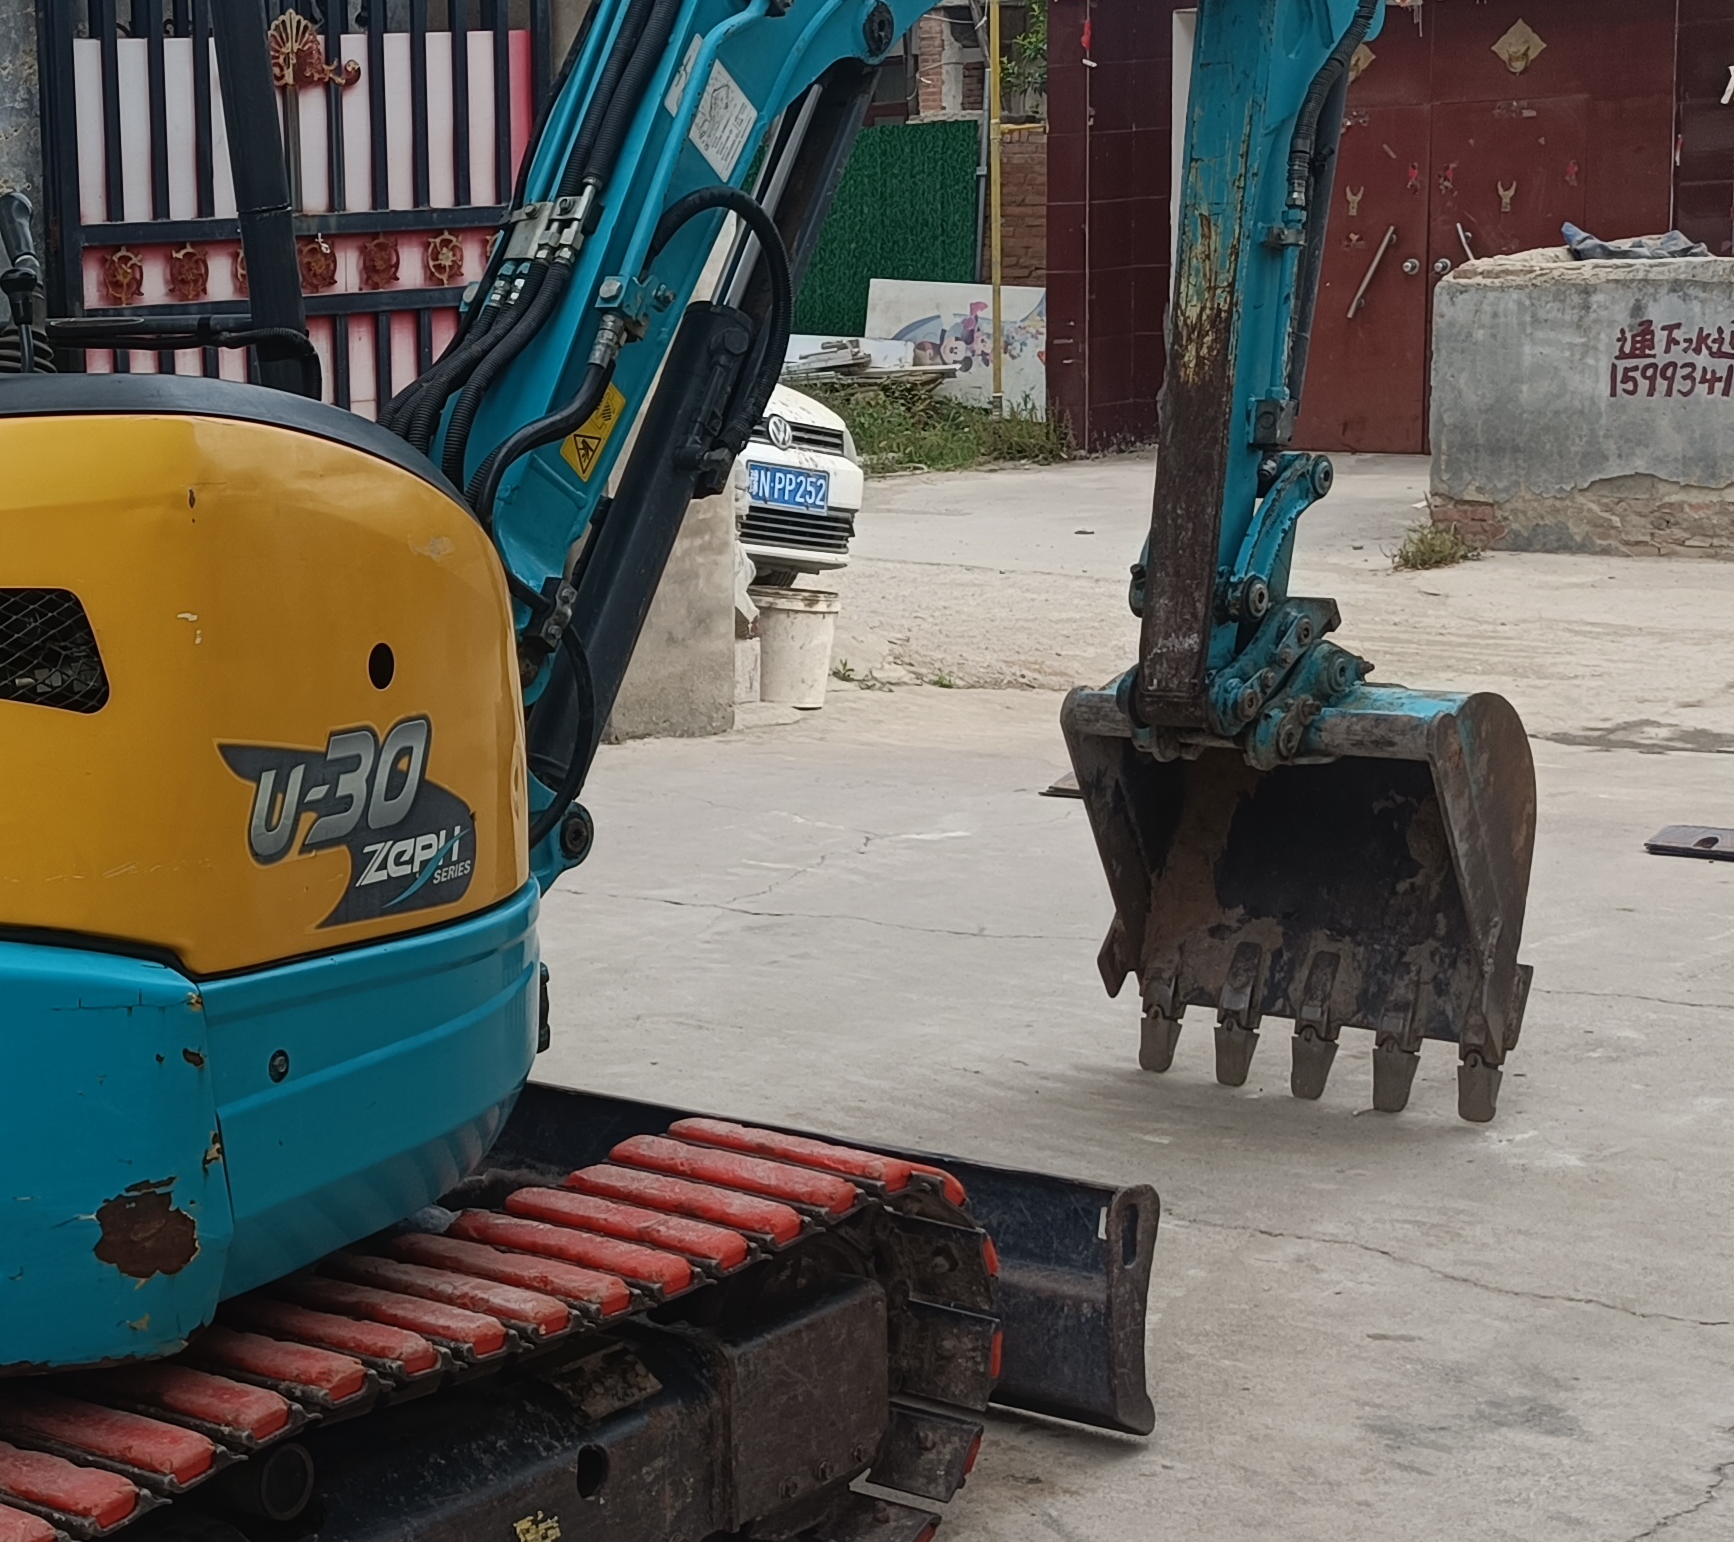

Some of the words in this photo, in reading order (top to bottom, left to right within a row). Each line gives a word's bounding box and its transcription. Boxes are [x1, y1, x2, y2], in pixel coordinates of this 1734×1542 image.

[1610, 361, 1734, 397] 1599341
[250, 719, 428, 857] U-30
[432, 859, 471, 885] SERIES
